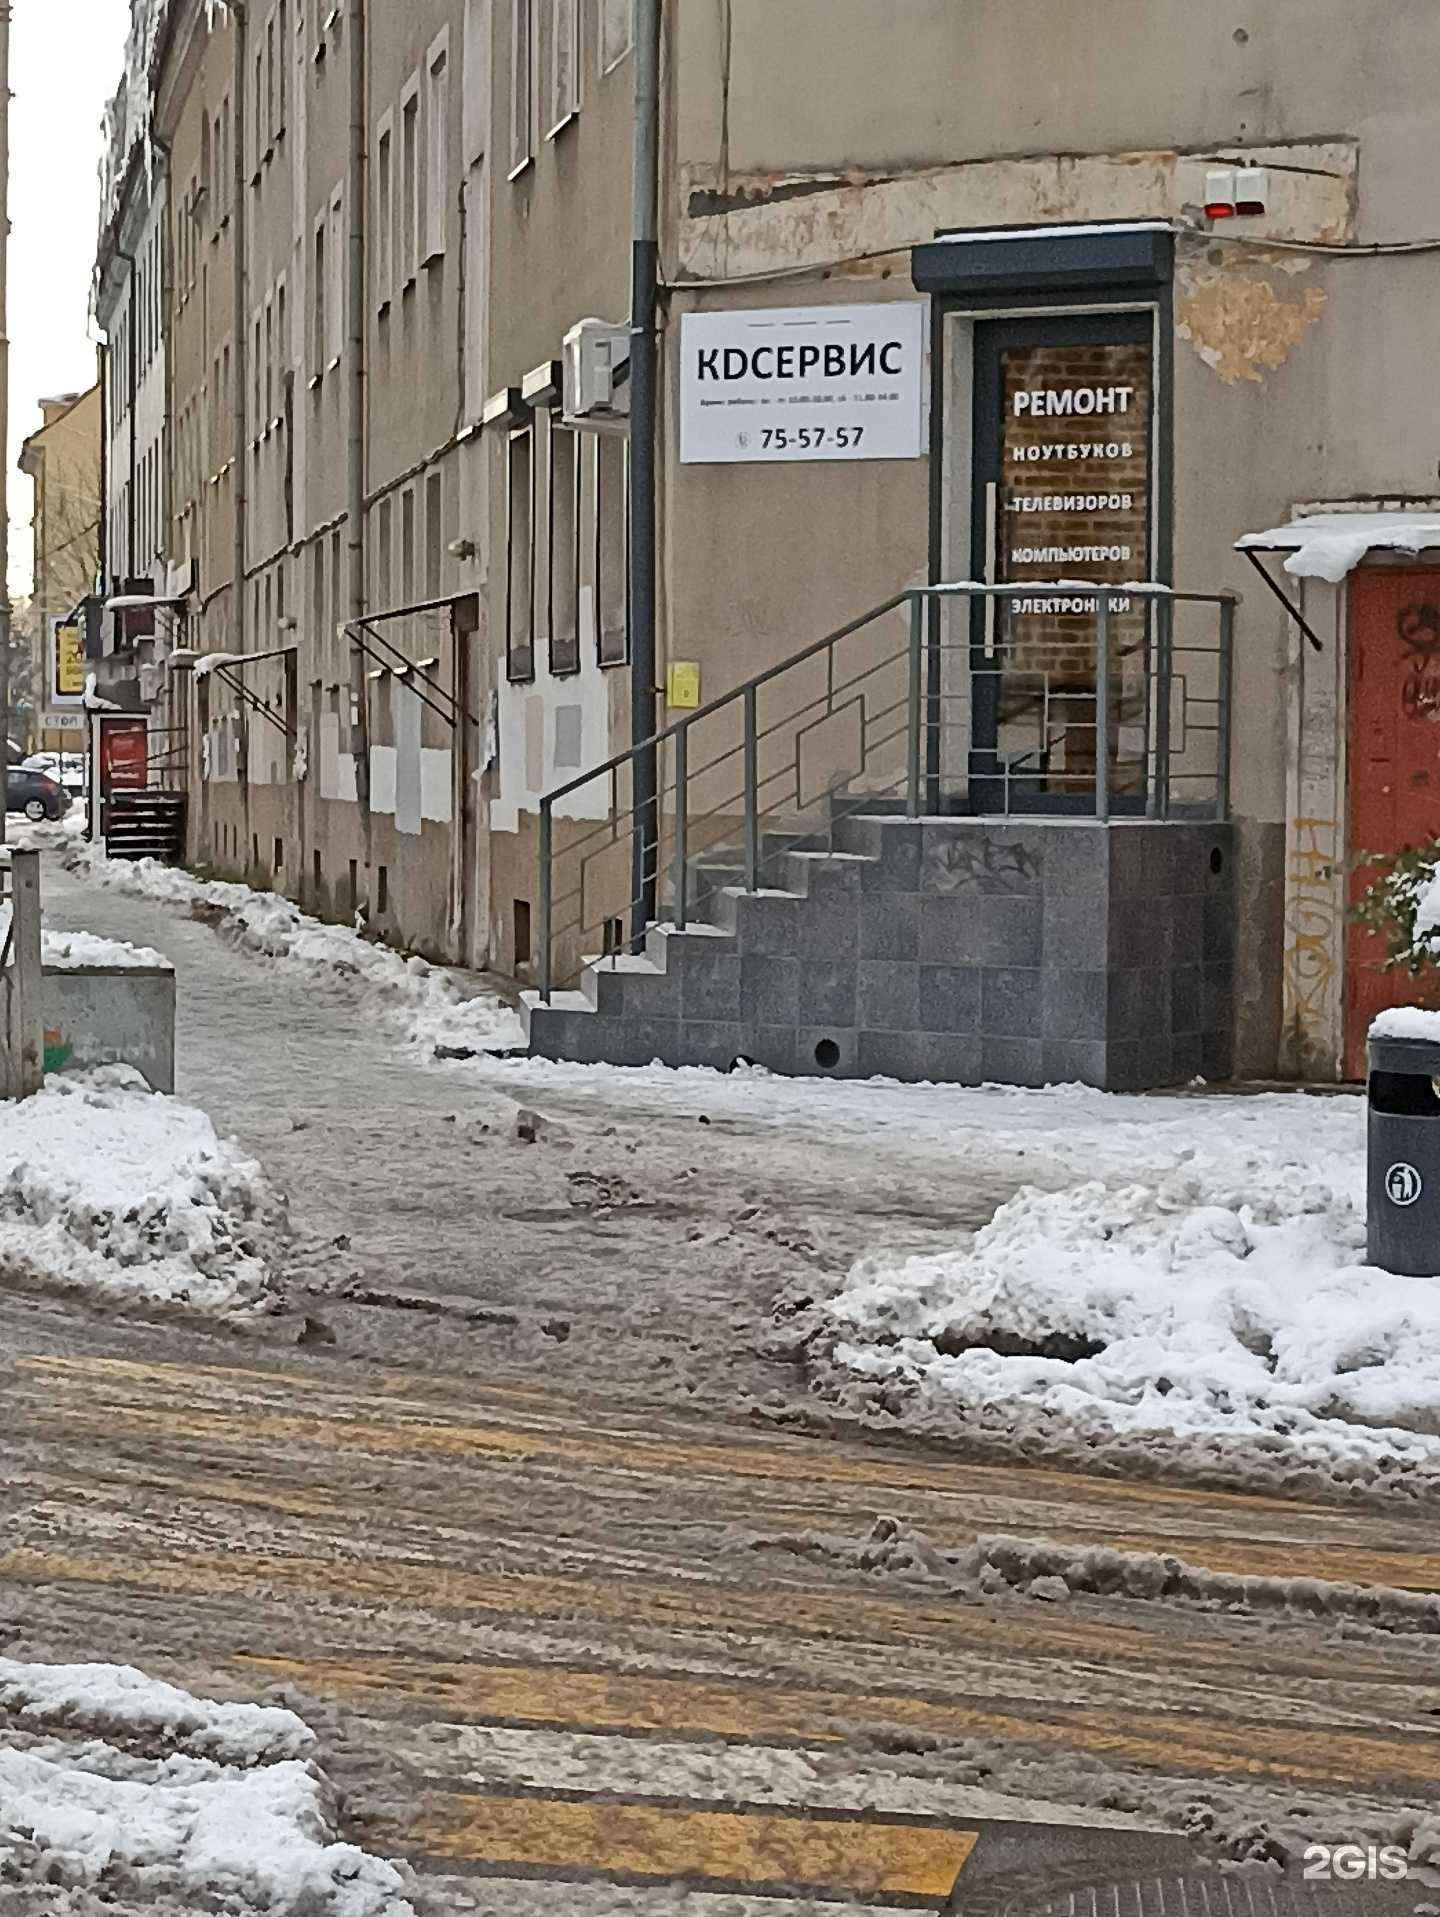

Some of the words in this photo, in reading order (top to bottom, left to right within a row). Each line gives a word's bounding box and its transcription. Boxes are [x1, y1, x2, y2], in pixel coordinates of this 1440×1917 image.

[1013, 386, 1134, 417] РЕМОНТ
[761, 426, 864, 449] 75-57-57
[1012, 443, 1134, 462] НОУТБУКОВ
[1012, 494, 1133, 513] ТЕЛЕВИЗОРОВ
[1011, 545, 1131, 563] КОМПЬЮТЕРОВ
